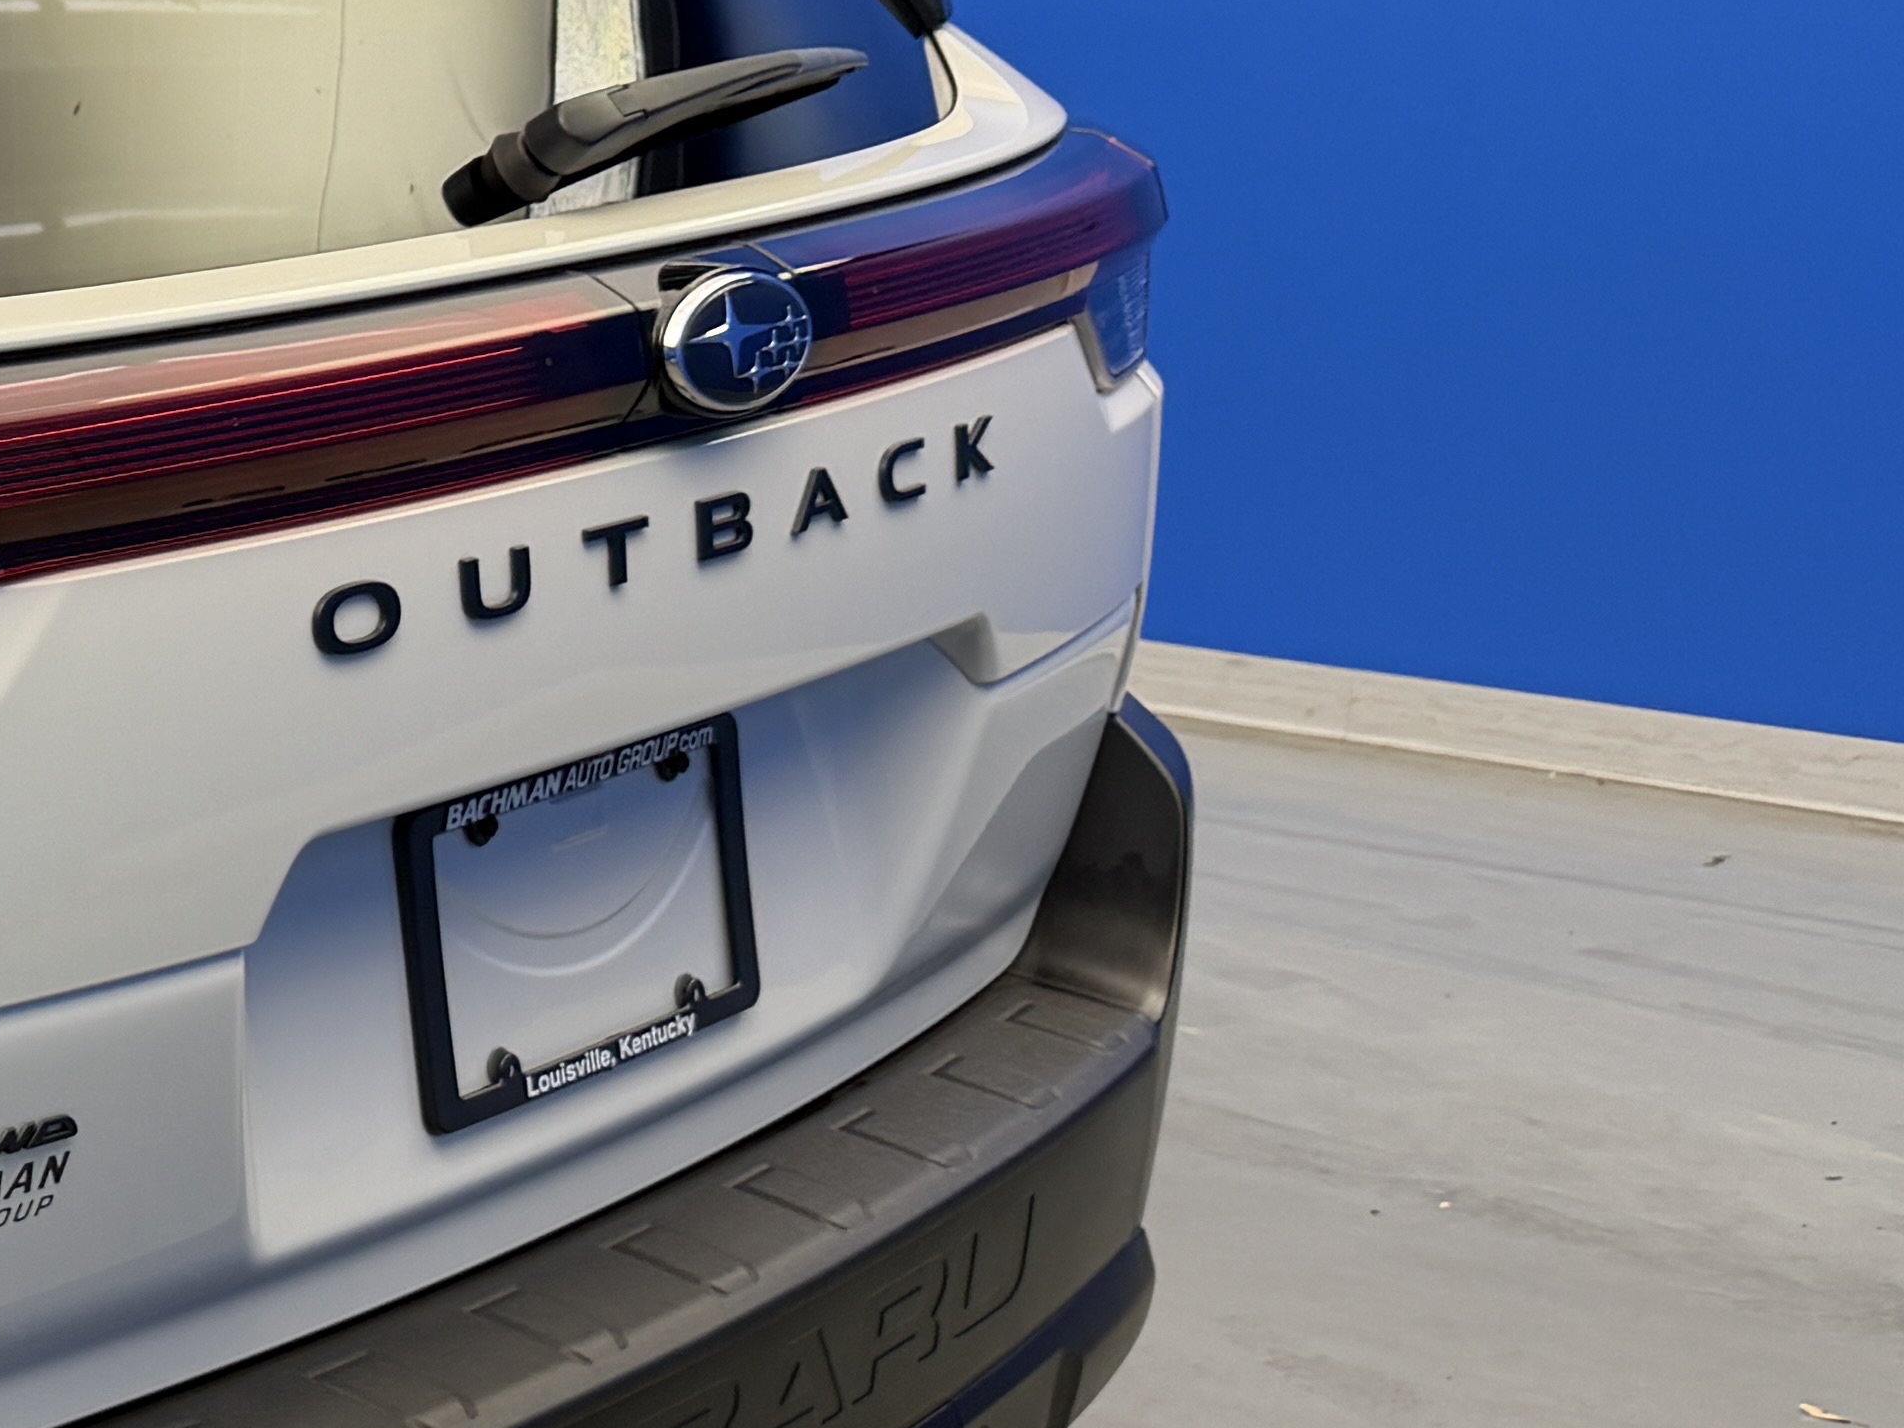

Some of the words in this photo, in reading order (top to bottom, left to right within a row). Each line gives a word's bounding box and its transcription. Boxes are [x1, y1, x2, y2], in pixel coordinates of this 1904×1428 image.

[311, 414, 995, 656] OUTBACK
[446, 770, 563, 831] BACHMAN
[563, 752, 613, 792] AUTO
[526, 1046, 616, 1098] Louisville,
[618, 1012, 696, 1059] Kentucky
